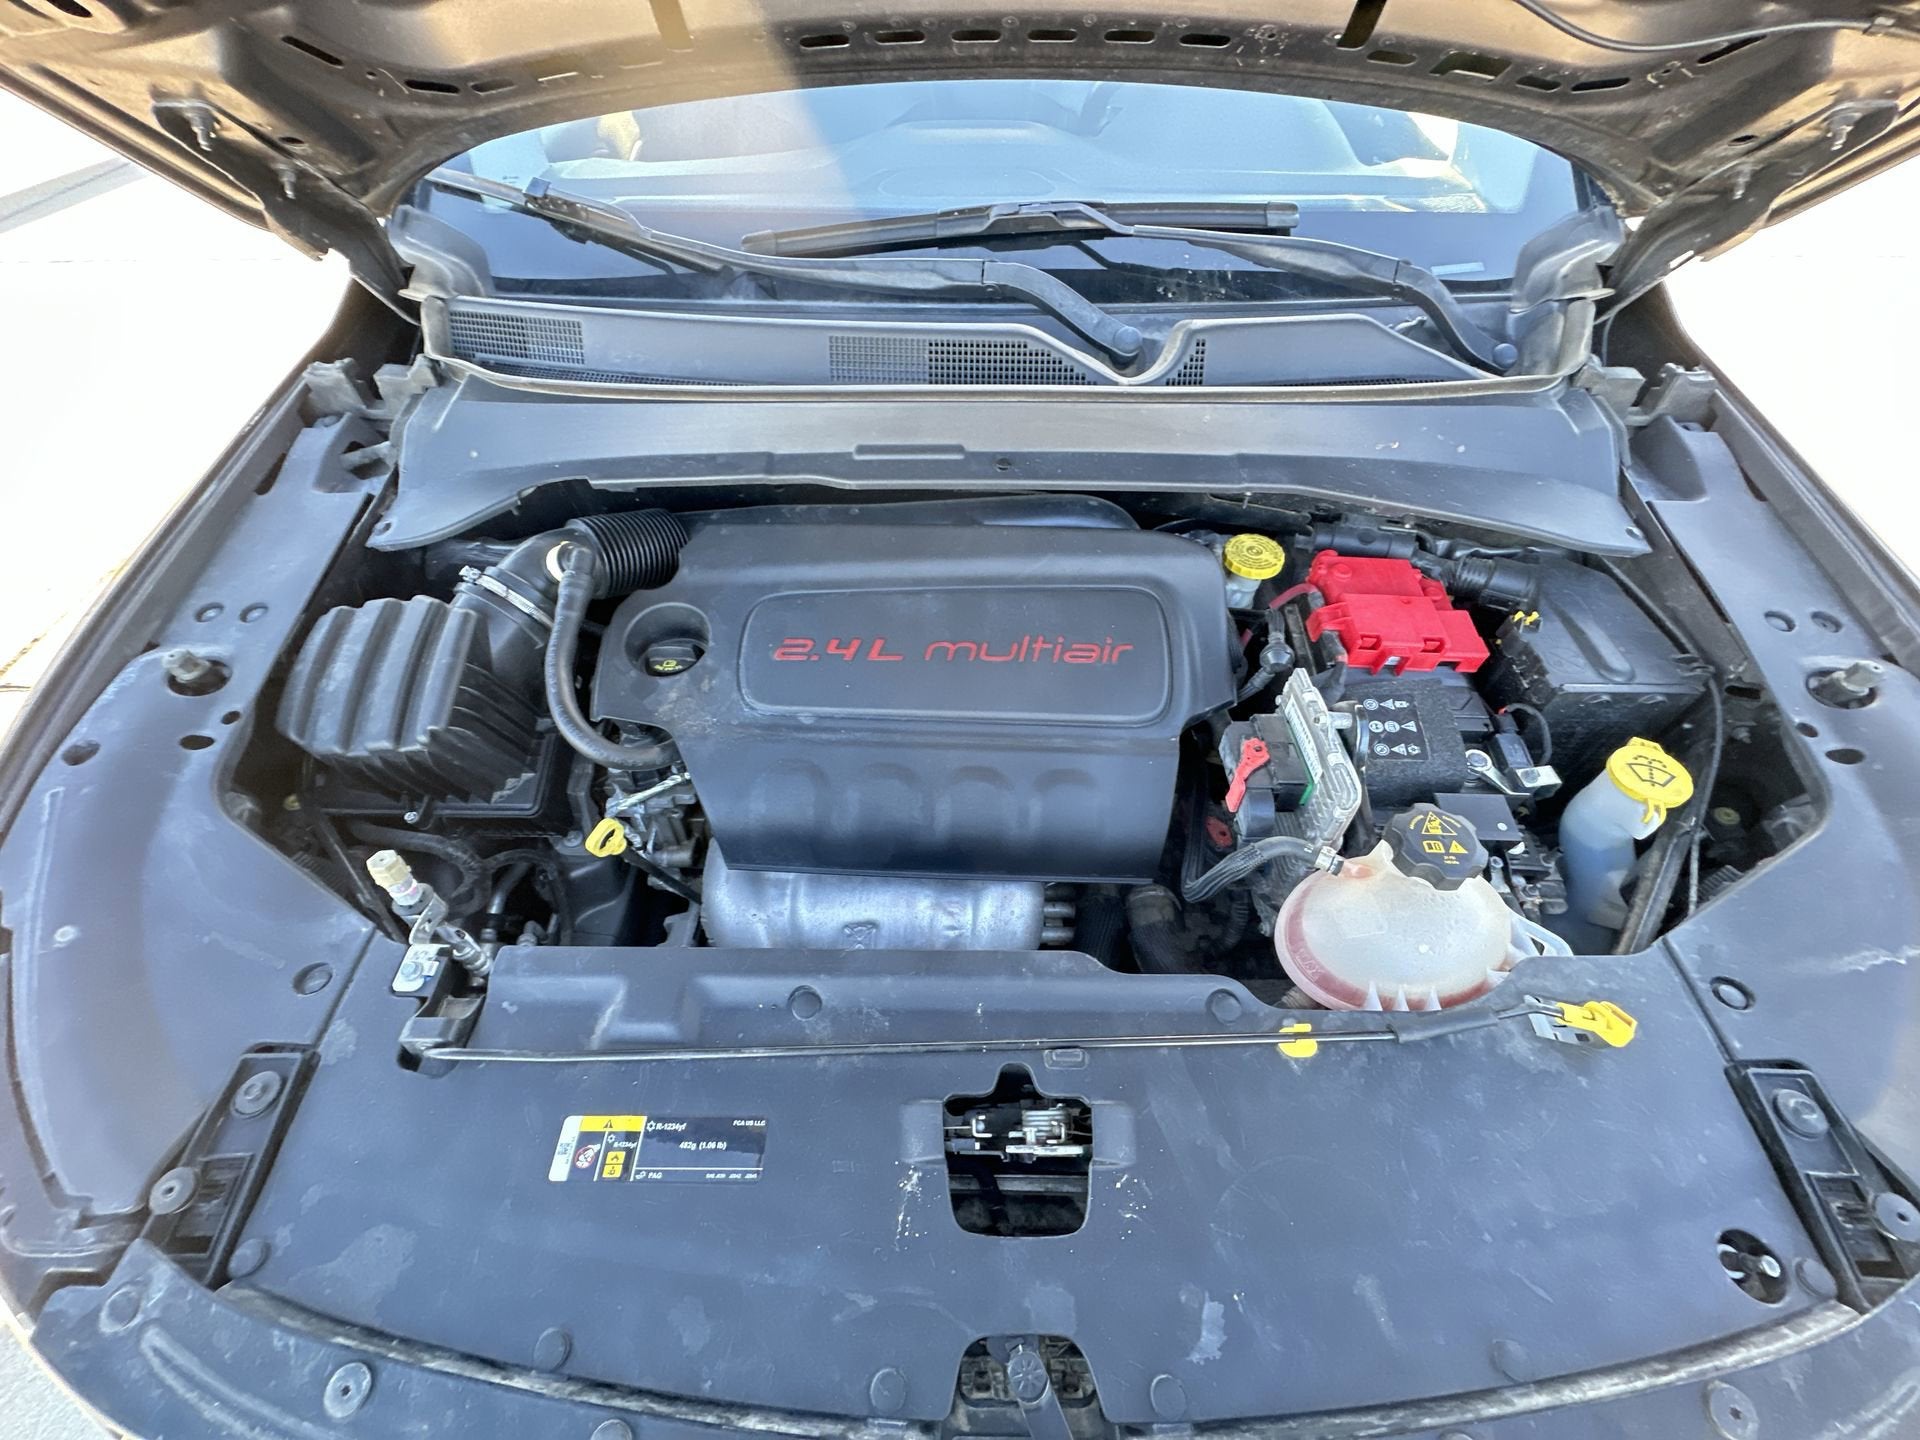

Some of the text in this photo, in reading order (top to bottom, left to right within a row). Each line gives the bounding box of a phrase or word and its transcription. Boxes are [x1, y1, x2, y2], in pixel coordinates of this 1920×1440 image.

[773, 635, 1134, 664] 2.4L multiair
[655, 1122, 687, 1132] R-1234yf
[679, 1141, 697, 1151] 482g
